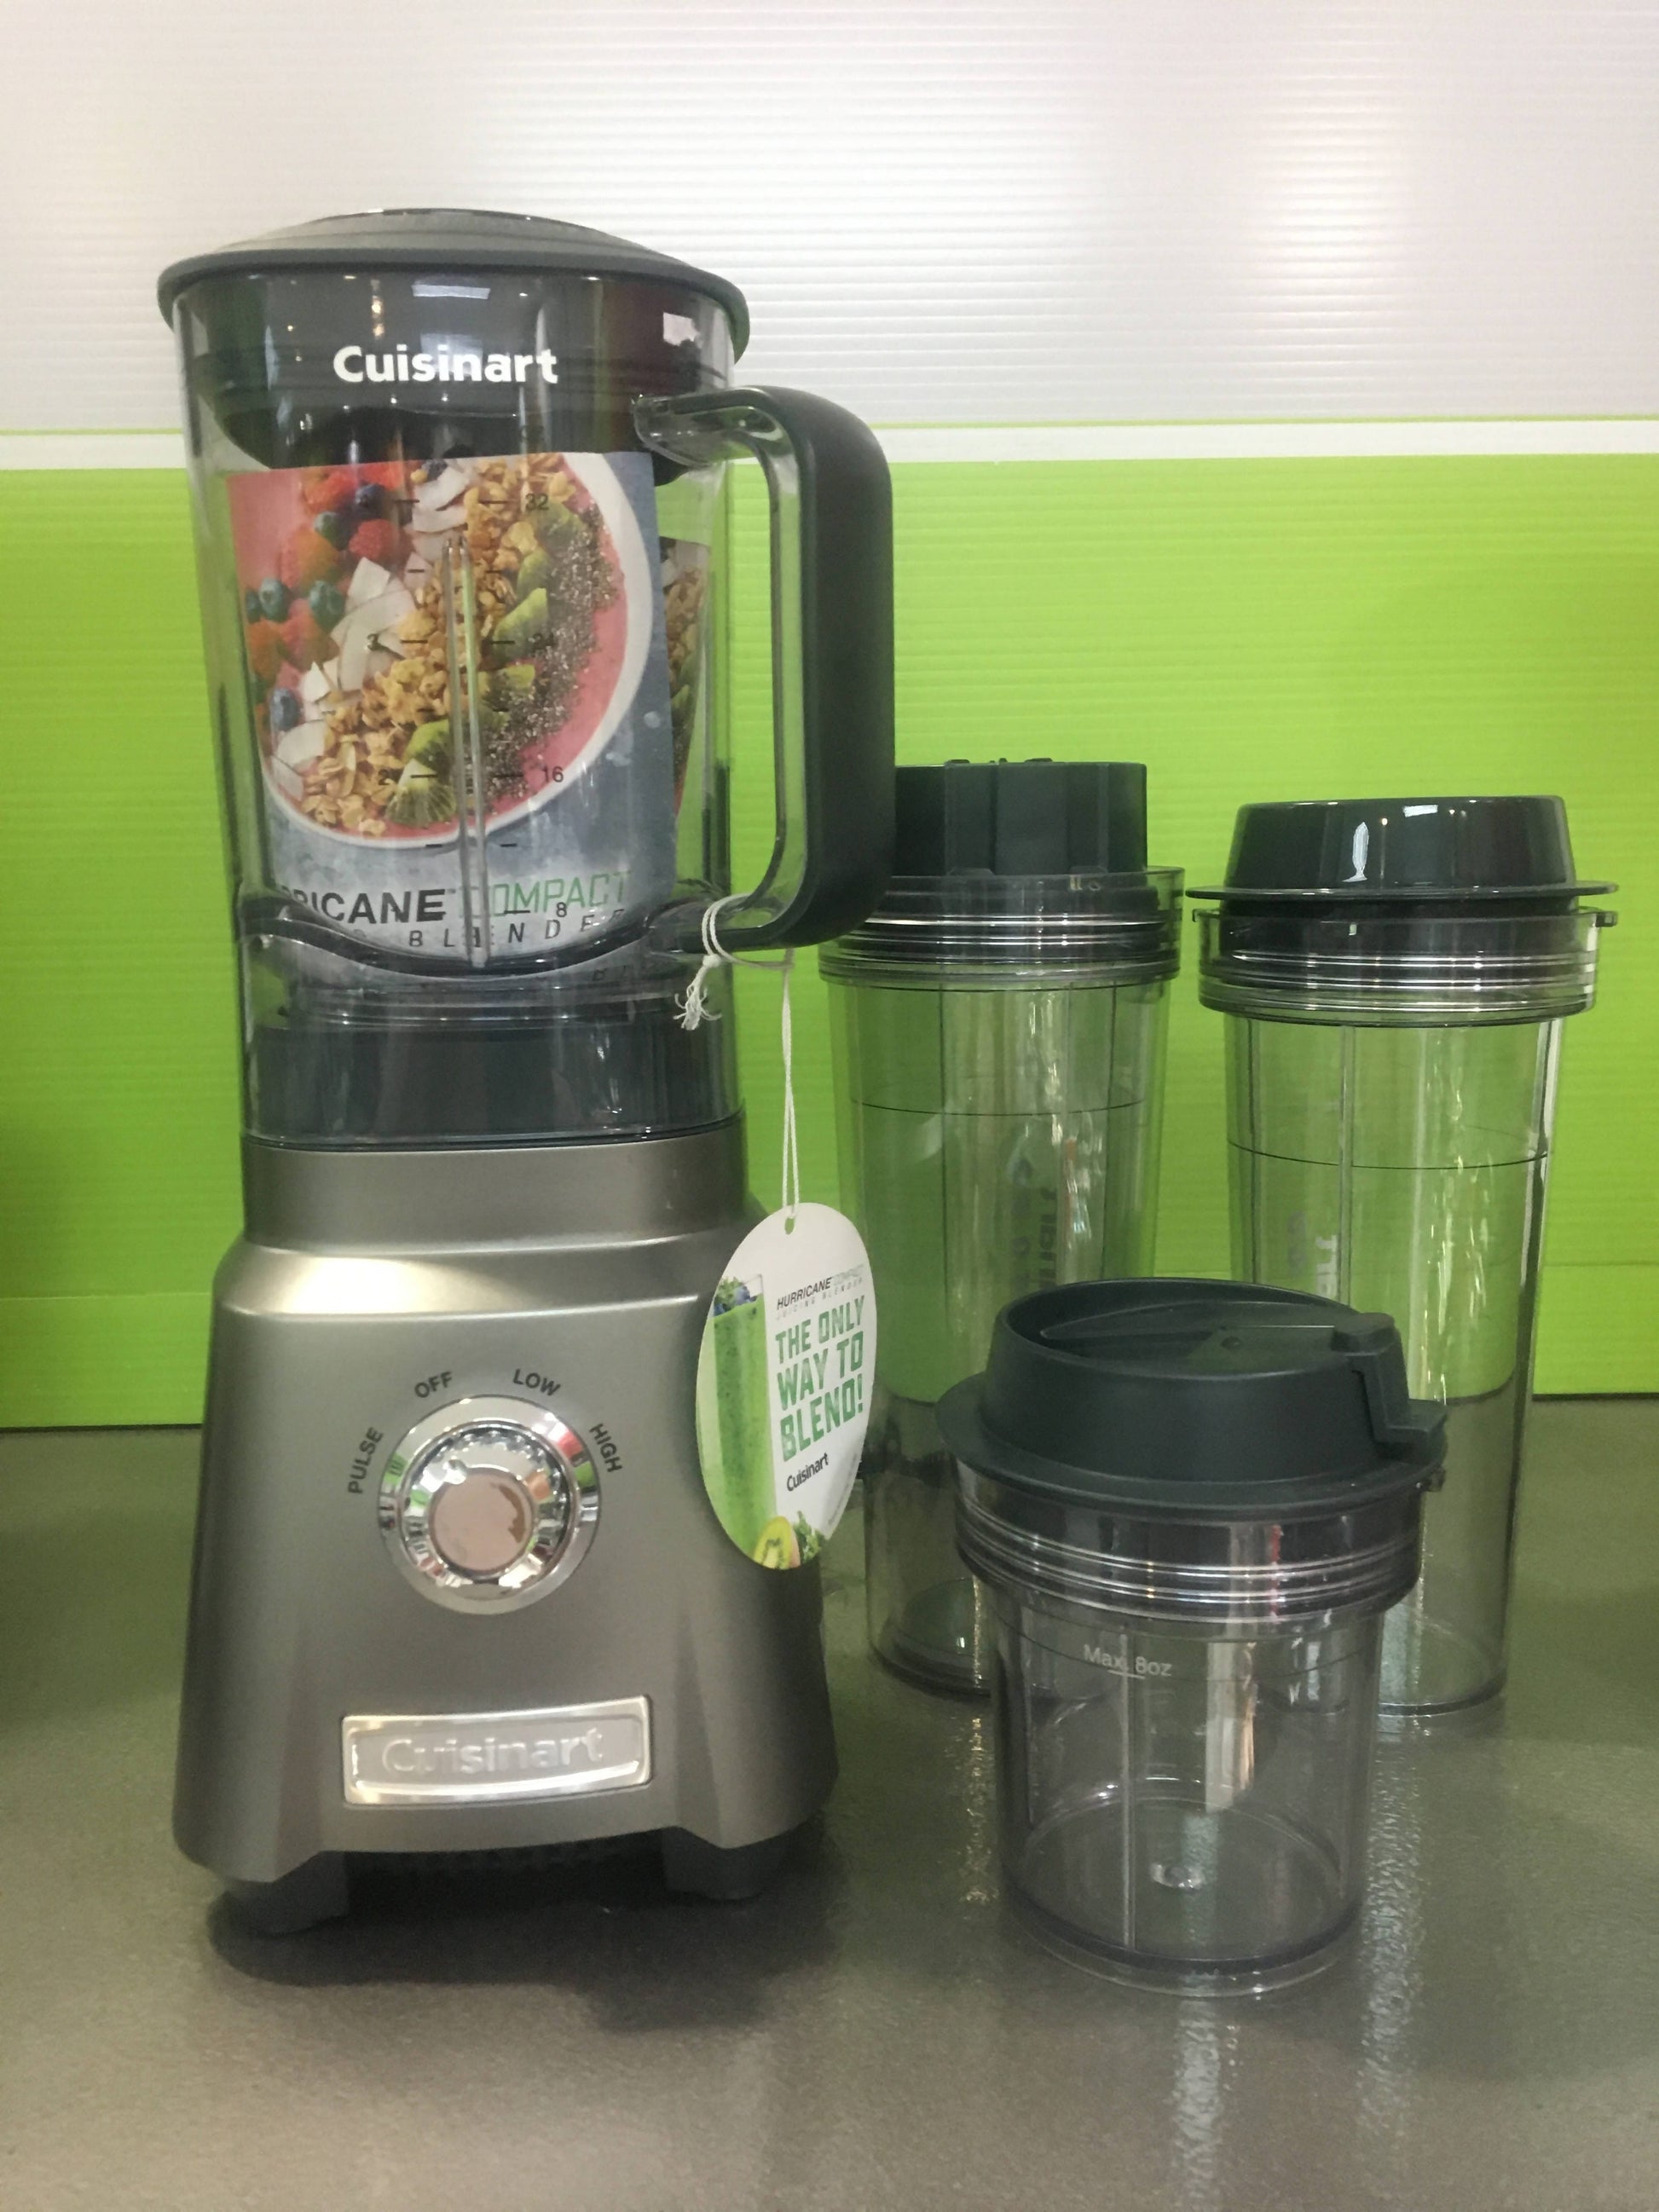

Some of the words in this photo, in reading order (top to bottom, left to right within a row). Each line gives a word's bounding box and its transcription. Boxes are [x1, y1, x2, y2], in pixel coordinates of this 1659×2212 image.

[332, 344, 559, 384] Cuisinart
[524, 493, 549, 511] 32
[542, 765, 564, 784] 16
[556, 901, 568, 918] 8
[777, 1277, 833, 1310] HURRICANE
[775, 1319, 812, 1365] THE
[818, 1295, 865, 1344] ONLY
[413, 1371, 454, 1399] OFF
[512, 1368, 562, 1397] LOW
[777, 1349, 829, 1411] WAY
[836, 1330, 864, 1378] TO
[780, 1373, 864, 1462] BLEND!
[347, 1427, 384, 1494] PULSE
[589, 1423, 624, 1474] HIGH
[786, 1453, 829, 1492] Cuisinart
[1135, 1655, 1173, 1677] 8oz
[381, 1727, 604, 1775] Cuisinart
